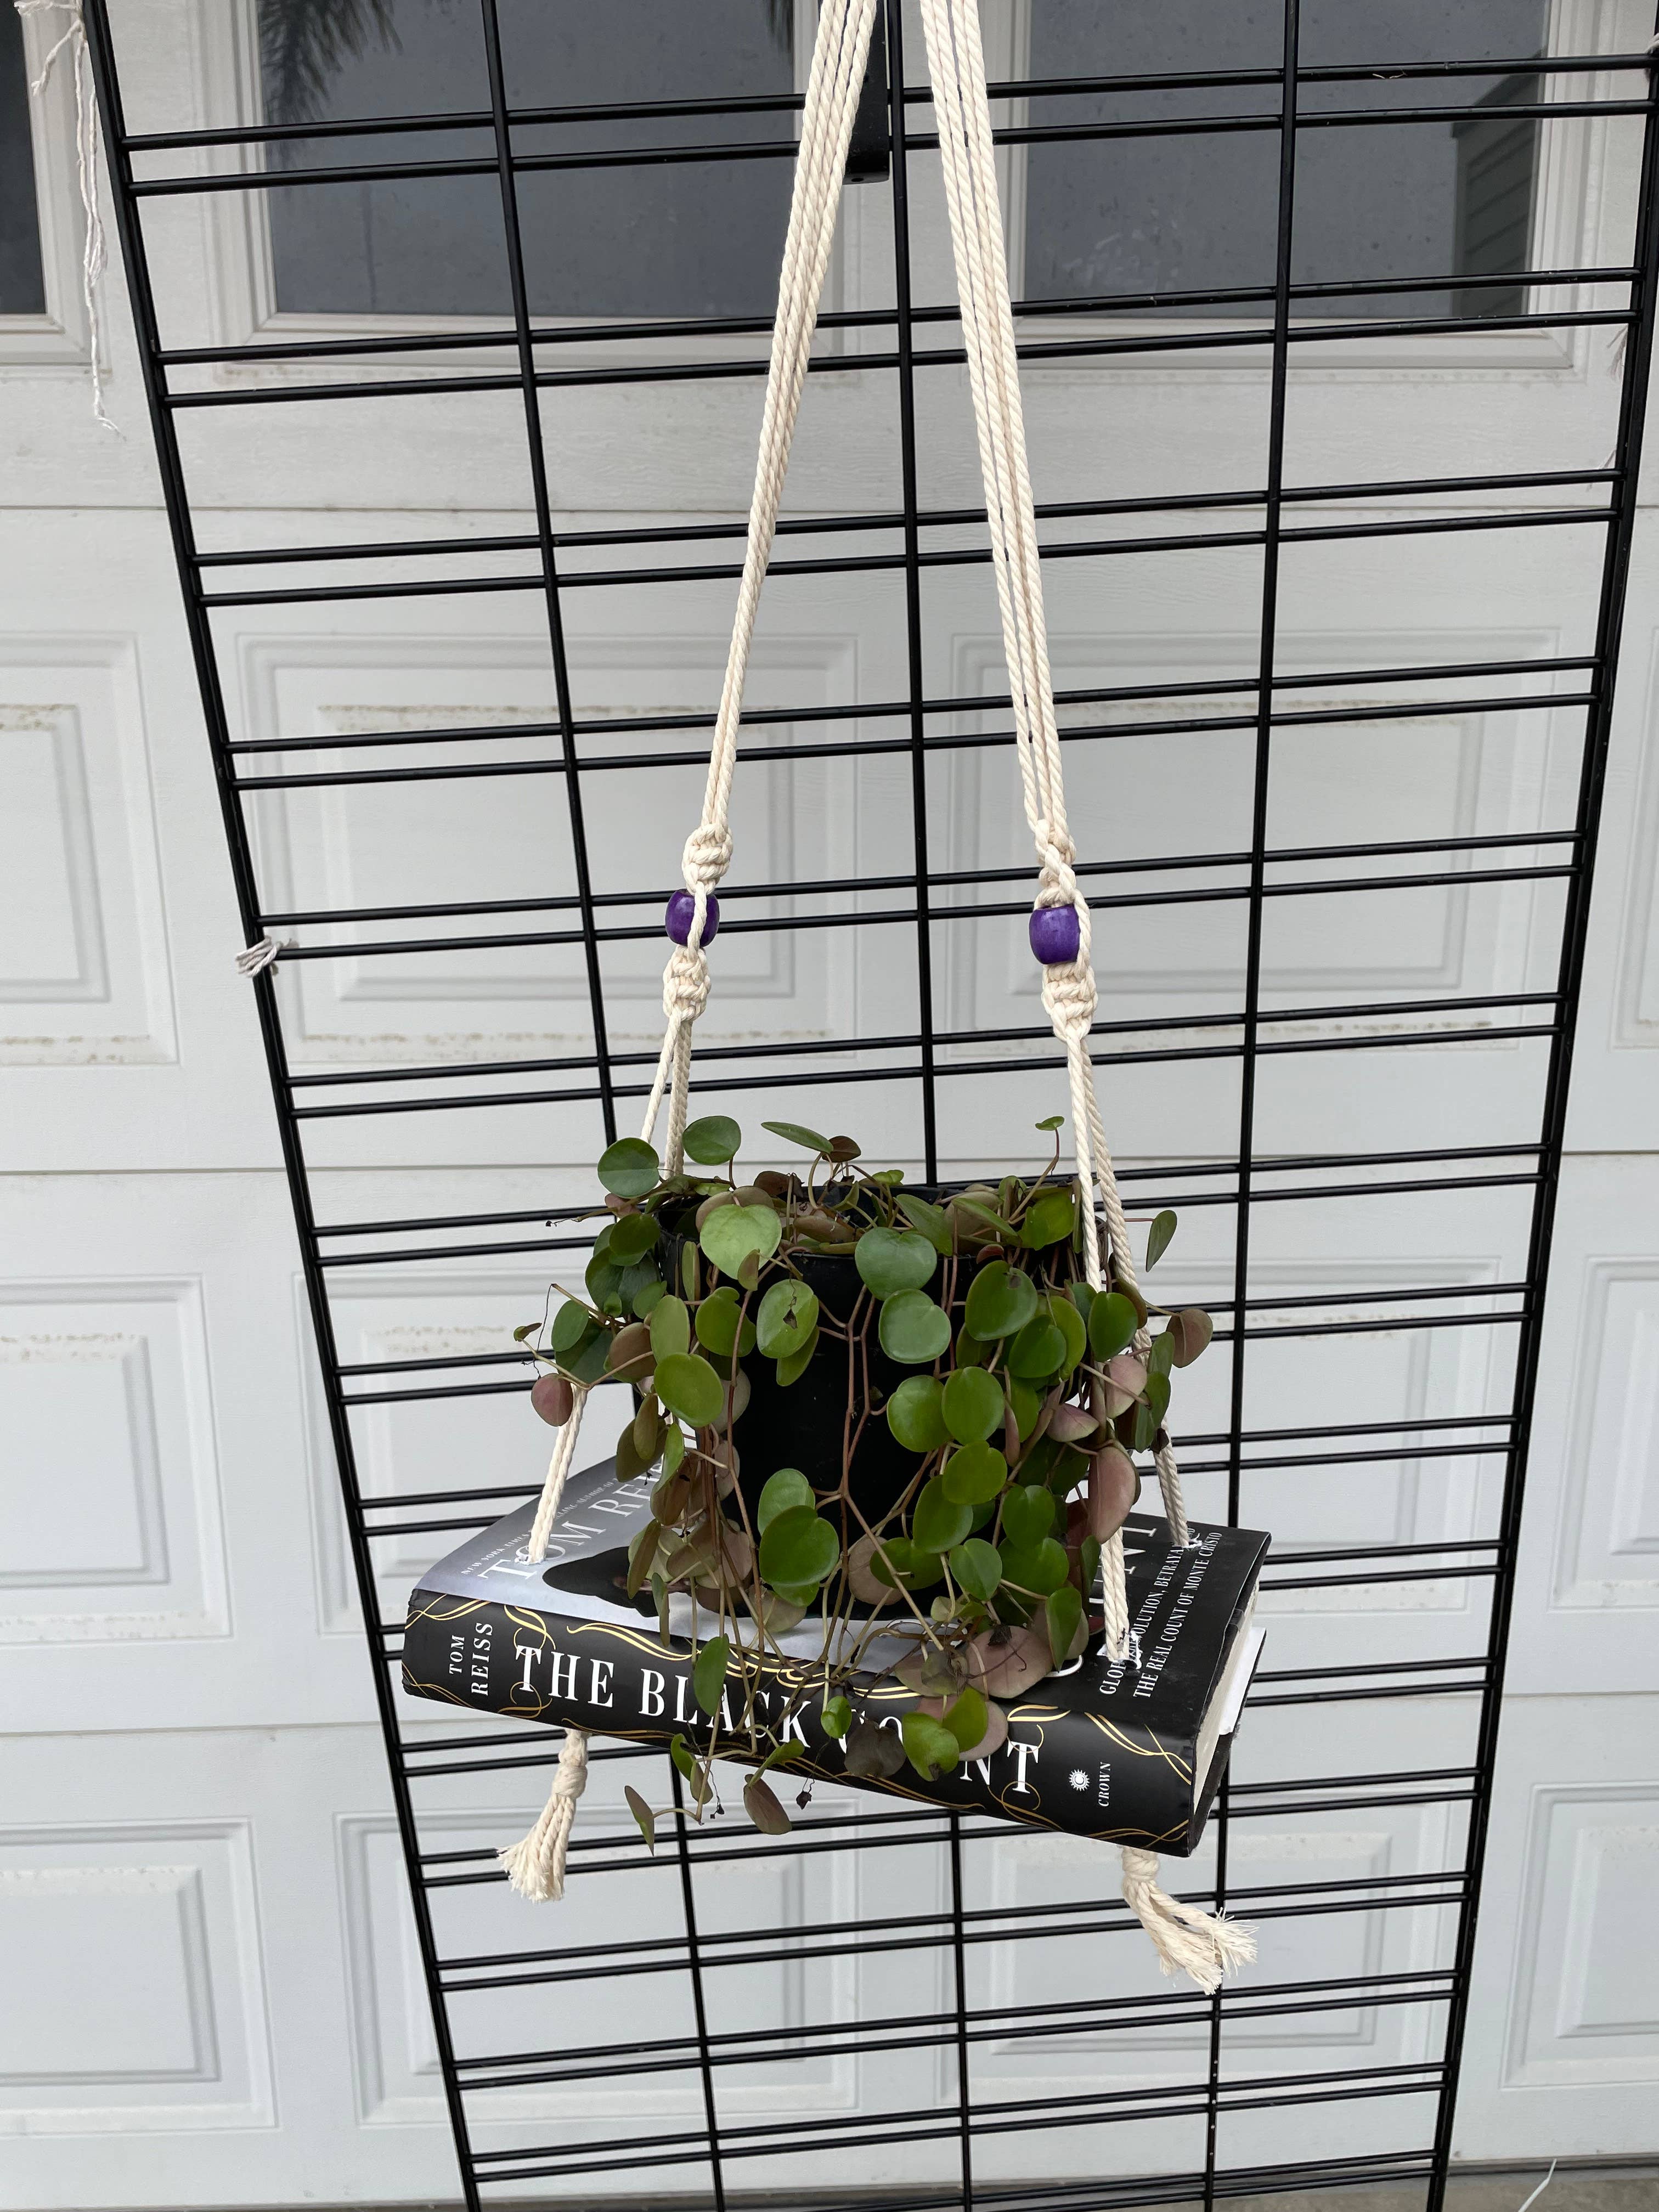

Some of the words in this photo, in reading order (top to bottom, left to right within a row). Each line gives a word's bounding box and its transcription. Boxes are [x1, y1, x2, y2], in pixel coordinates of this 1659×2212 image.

[477, 1520, 606, 1580] TOM
[588, 1453, 663, 1517] REI
[1198, 1532, 1222, 1557] CRISTO
[1153, 1544, 1185, 1587] BETRAYA
[1183, 1559, 1210, 1591] MONTE
[1177, 1592, 1194, 1605] OF
[1160, 1607, 1188, 1641] COUNT
[449, 1634, 465, 1674] TOM
[471, 1622, 493, 1696] REISS
[1146, 1645, 1172, 1671] REAL
[515, 1645, 614, 1708] THE
[638, 1668, 811, 1748] BLACK
[1133, 1672, 1159, 1697] THE
[1098, 1761, 1111, 1807] CROWN
